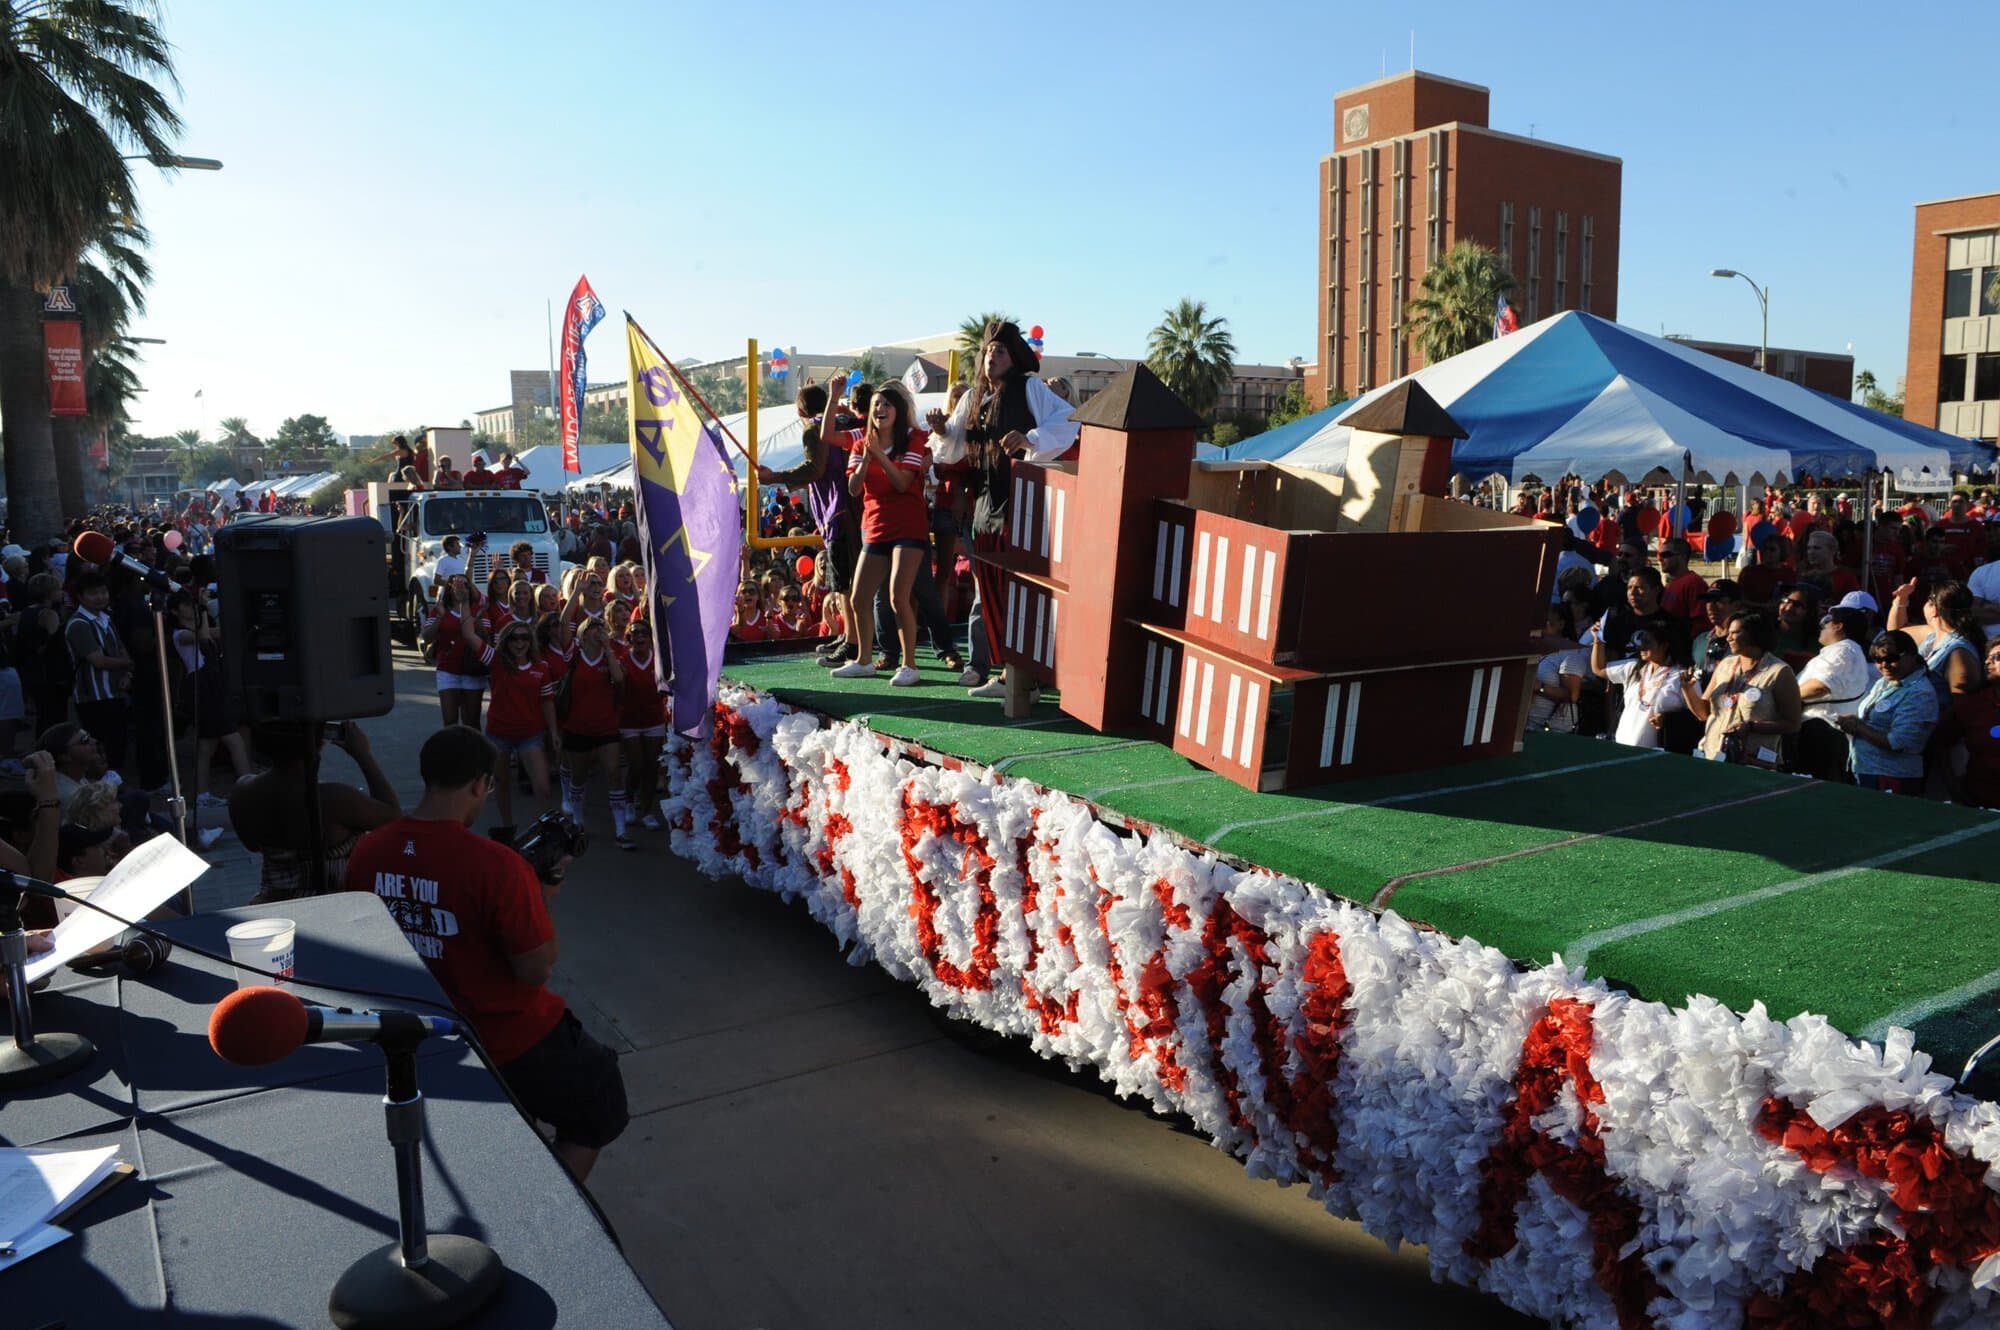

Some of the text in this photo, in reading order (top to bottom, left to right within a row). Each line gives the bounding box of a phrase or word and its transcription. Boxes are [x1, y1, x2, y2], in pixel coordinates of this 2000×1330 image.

[44, 286, 76, 311] A
[374, 872, 439, 905] ARE YOU
